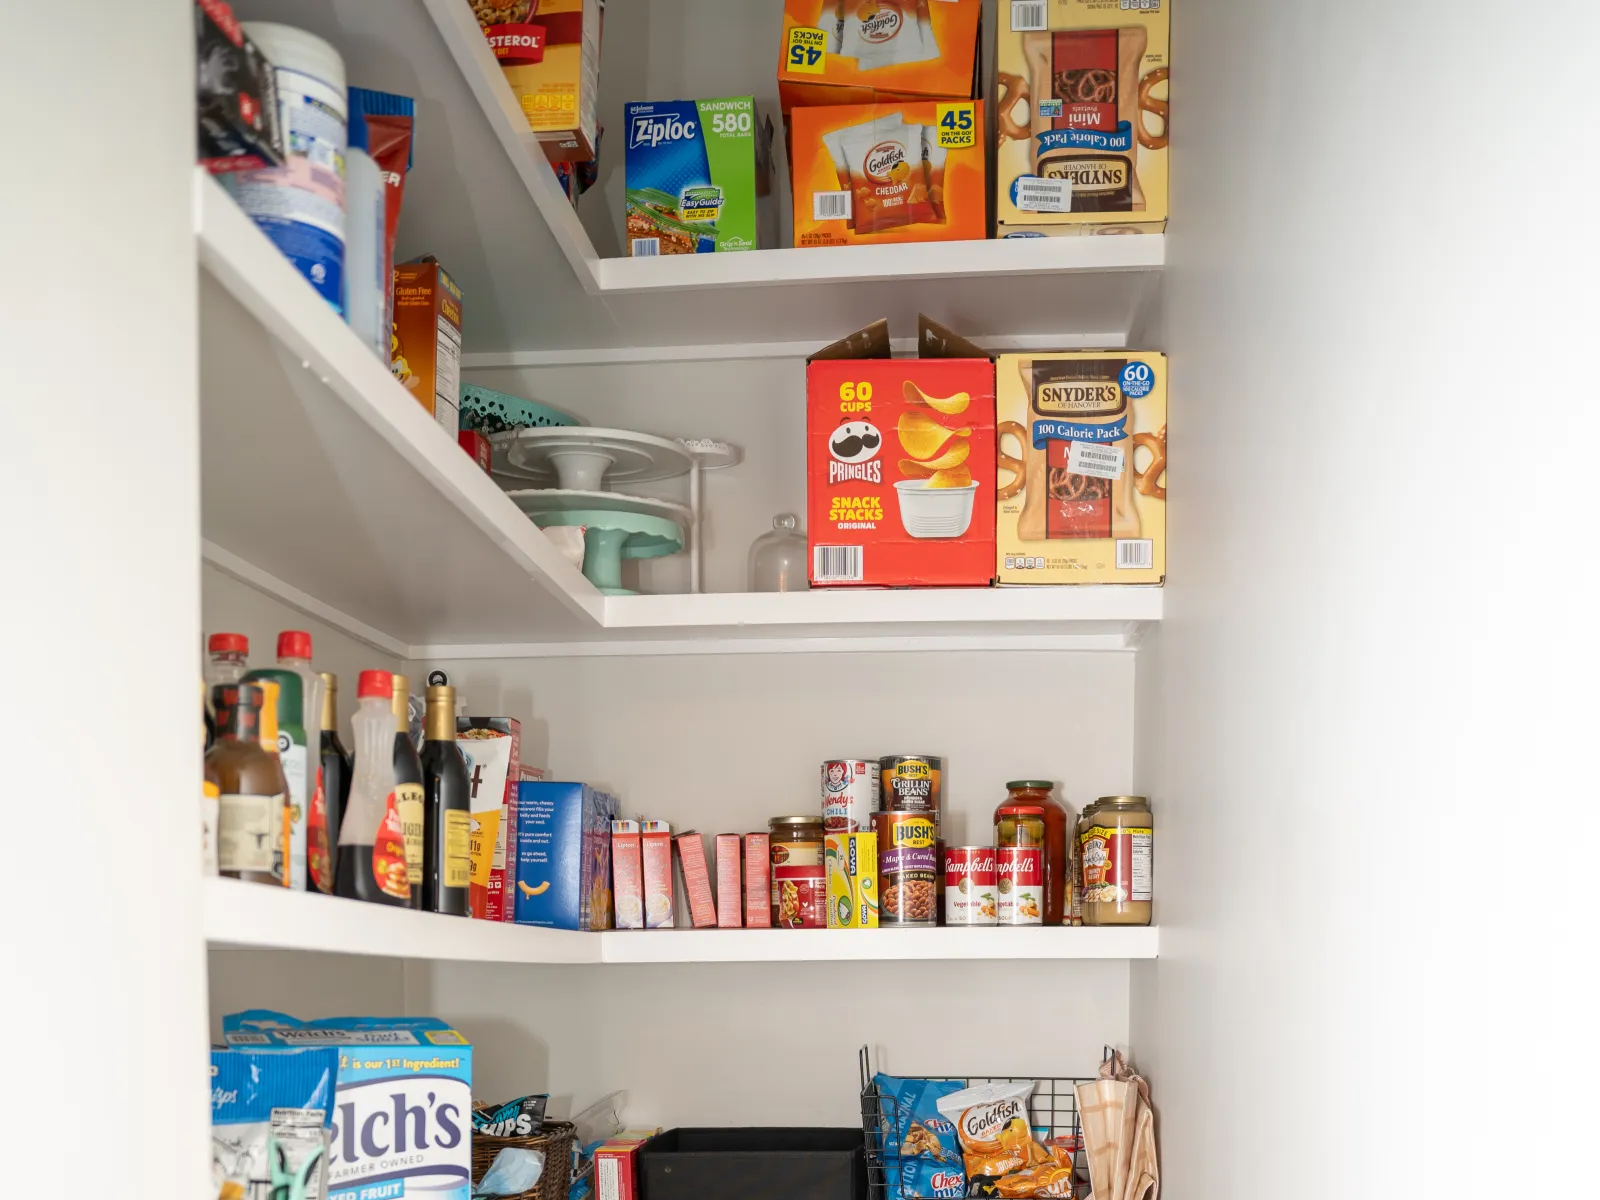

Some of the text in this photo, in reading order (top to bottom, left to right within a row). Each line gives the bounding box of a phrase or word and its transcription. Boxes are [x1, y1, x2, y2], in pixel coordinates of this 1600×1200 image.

[860, 14, 898, 34] Goldfish
[793, 30, 824, 40] PACKS
[790, 44, 822, 66] 45
[700, 102, 751, 112] SANDWICH
[712, 113, 751, 133] 580
[940, 110, 972, 130] 45
[1069, 113, 1100, 126] Mini
[636, 118, 695, 148] Ziploc
[1044, 134, 1126, 147] 100 Calorie Pack
[869, 148, 905, 173] Goldfish
[1048, 170, 1122, 184] SNYDERS
[876, 182, 908, 196] CHEDDAR
[680, 198, 724, 208] EasyGuide
[396, 287, 417, 295] Gluten
[1124, 365, 1148, 380] 60
[840, 382, 872, 401] 60
[1042, 386, 1116, 402] SNYDER'S
[840, 402, 872, 412] CUPS
[1038, 424, 1120, 438] 100 Calorie Pack
[829, 460, 882, 484] PRINGLES
[832, 496, 880, 509] SNACK
[829, 509, 884, 521] STACKS
[898, 766, 928, 775] BUSH'S
[825, 792, 854, 808] Wendys
[896, 826, 934, 841] BUSH'S
[945, 858, 993, 875] Campbell's
[353, 1058, 362, 1068] is
[364, 1060, 383, 1068] our
[403, 1058, 459, 1072] Ingredient!
[967, 1101, 1020, 1136] Goldfish
[328, 1090, 462, 1166] elch's
[328, 1155, 424, 1180] FARMER OWNED
[932, 1172, 963, 1188] Chex
[360, 1183, 401, 1200] FRUIT
[934, 1183, 963, 1198] mix
